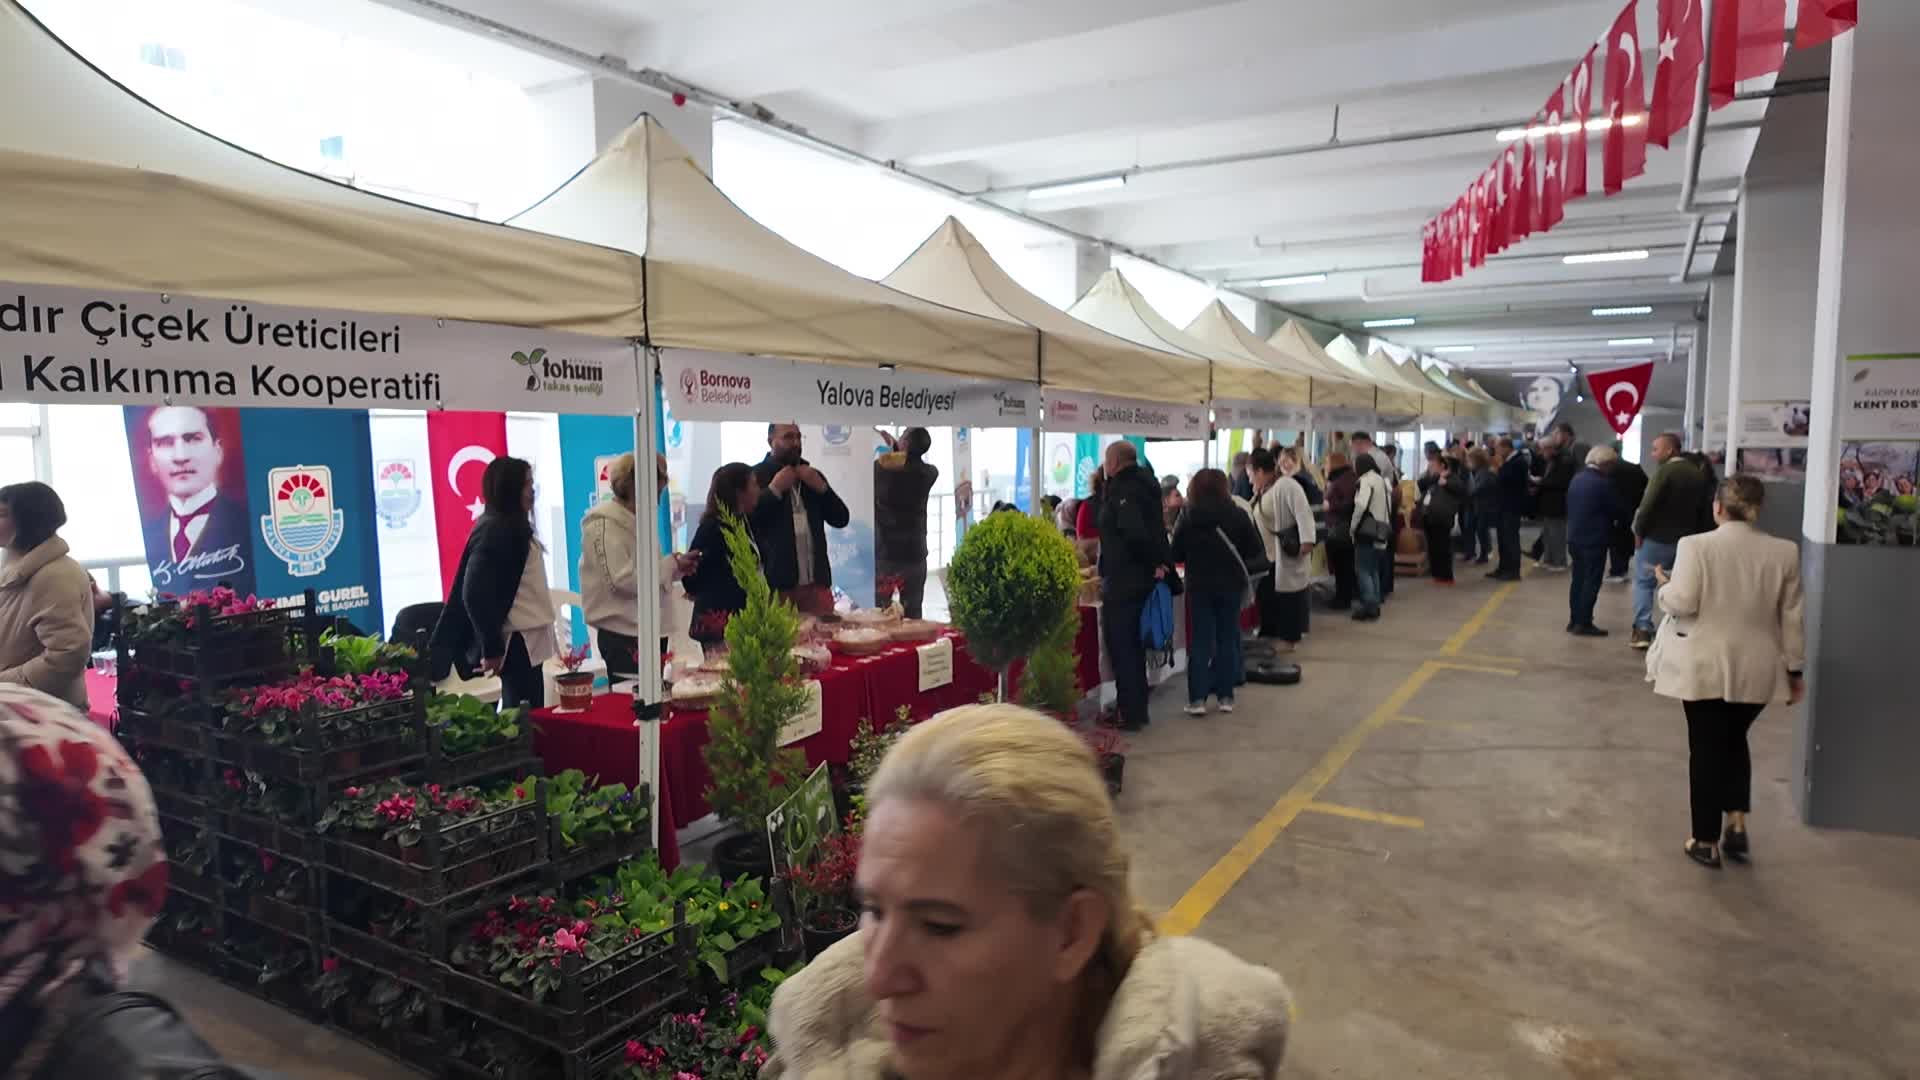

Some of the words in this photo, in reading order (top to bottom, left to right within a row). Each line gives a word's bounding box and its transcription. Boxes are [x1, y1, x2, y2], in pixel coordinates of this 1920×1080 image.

[81, 300, 209, 347] Çiçek
[225, 304, 399, 353] Üreticileri
[24, 354, 236, 395] Kalkınma
[251, 364, 440, 404] Kooperatifi
[543, 357, 602, 381] tohum
[700, 370, 751, 389] Bornova
[701, 387, 751, 408] Belediyesi
[817, 379, 874, 407] Yalova
[880, 385, 956, 415] Belediyesi
[1854, 400, 1888, 409] KENT
